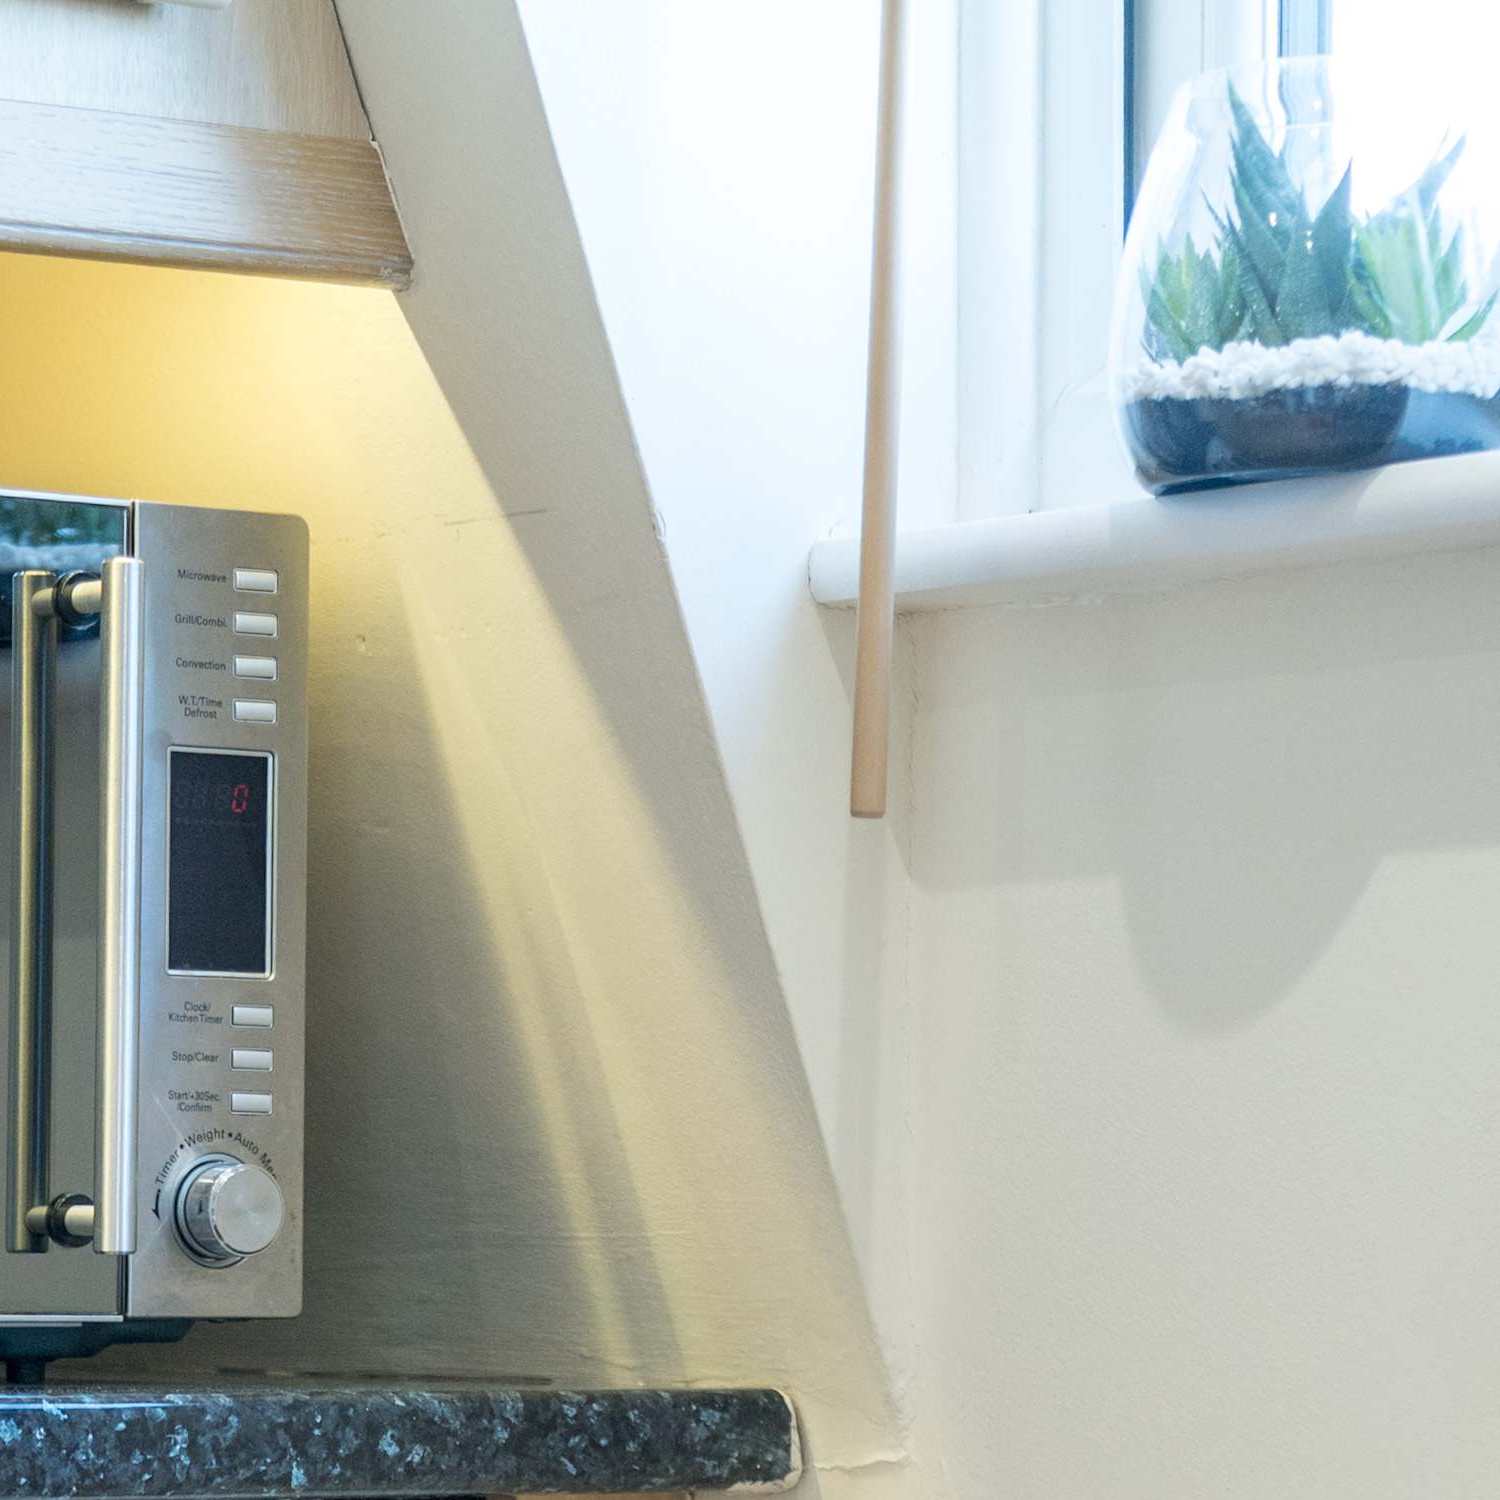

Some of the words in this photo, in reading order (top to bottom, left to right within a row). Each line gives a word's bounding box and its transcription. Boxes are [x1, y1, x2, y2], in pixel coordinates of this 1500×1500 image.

[177, 569, 227, 583] Microwave
[175, 657, 226, 671] Convection
[184, 707, 217, 719] Defrost
[168, 1012, 198, 1023] Kitchen
[199, 1013, 224, 1024] Timer
[172, 1051, 219, 1063] Stop/Clear
[154, 1149, 180, 1186] Timer
[184, 1128, 226, 1150] Weight
[233, 1132, 260, 1155] Auto
